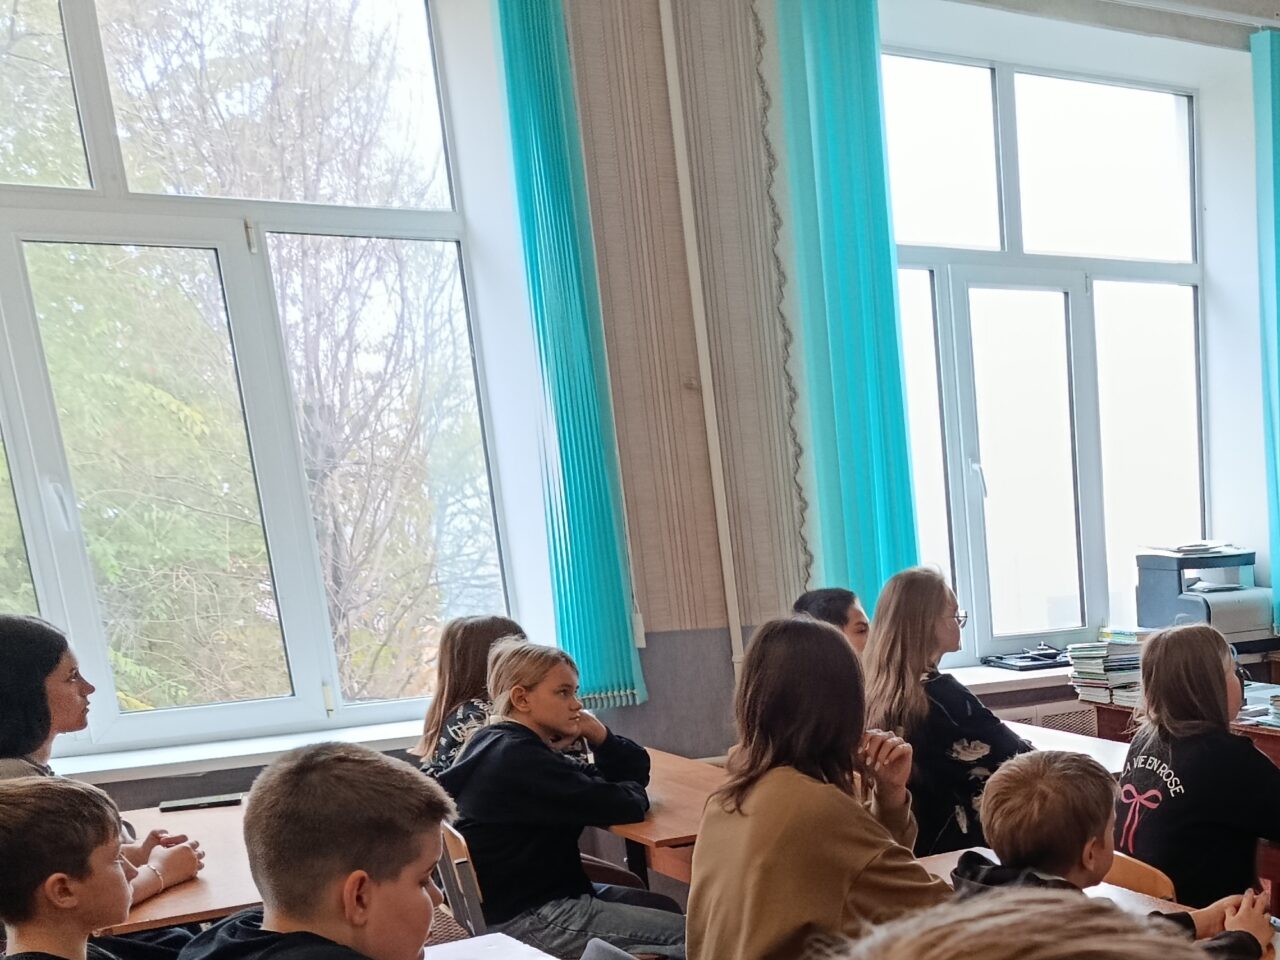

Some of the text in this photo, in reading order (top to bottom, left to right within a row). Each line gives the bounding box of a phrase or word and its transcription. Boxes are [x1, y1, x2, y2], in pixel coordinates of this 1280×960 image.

[1133, 755, 1148, 769] VIE
[1145, 756, 1161, 771] EN
[1156, 763, 1185, 798] ROSE
